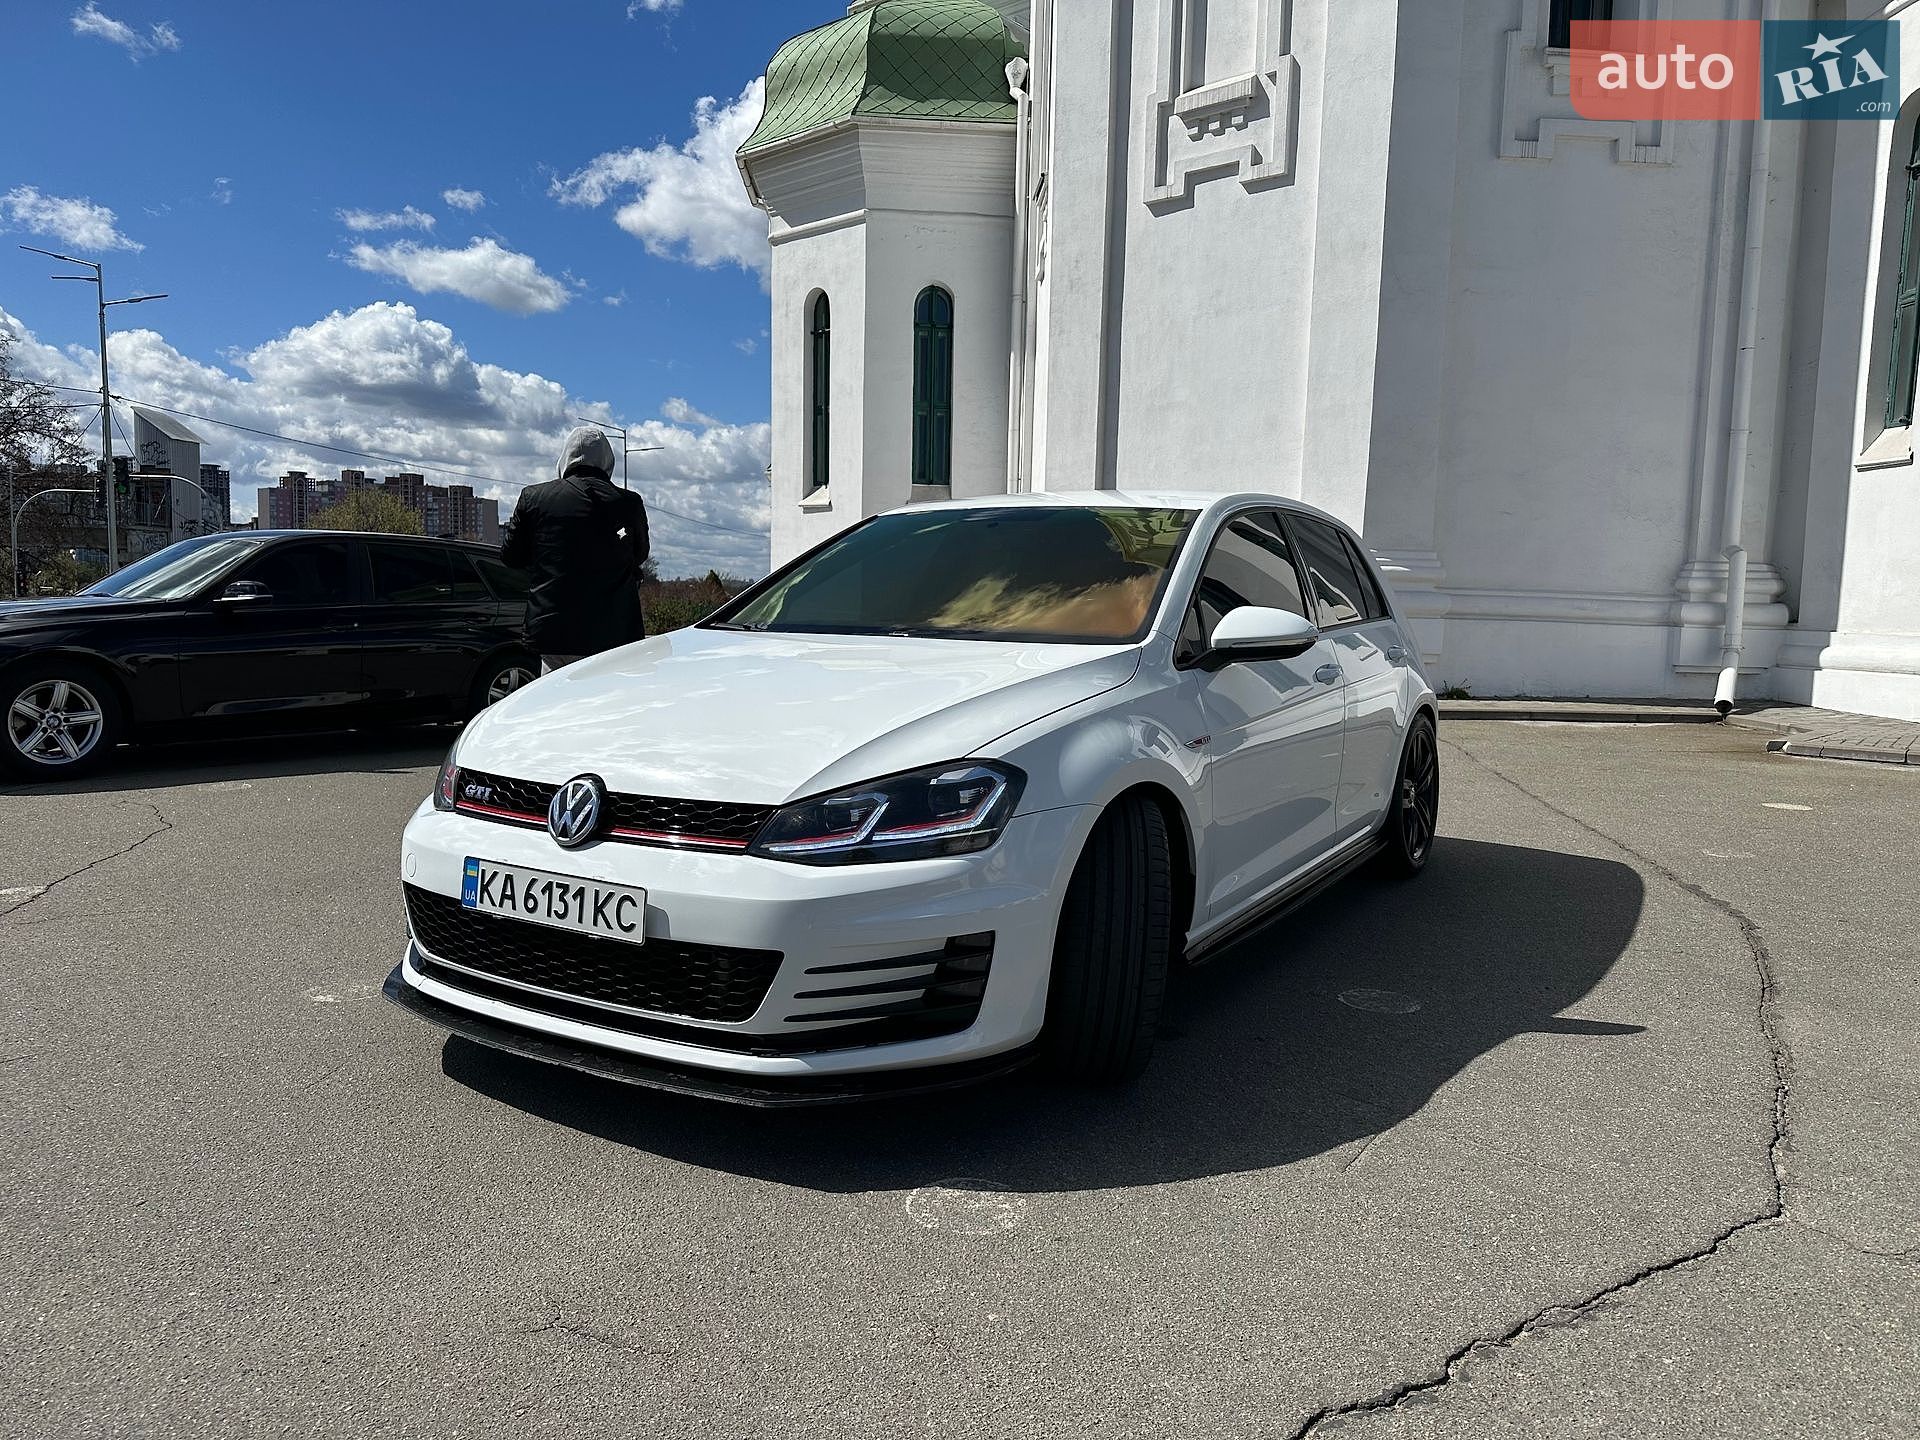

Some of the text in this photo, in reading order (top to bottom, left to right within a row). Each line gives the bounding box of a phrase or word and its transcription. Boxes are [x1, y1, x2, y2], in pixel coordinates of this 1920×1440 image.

[465, 784, 492, 800] GTI
[465, 889, 476, 902] UA
[479, 868, 638, 933] KA 6131 KC
